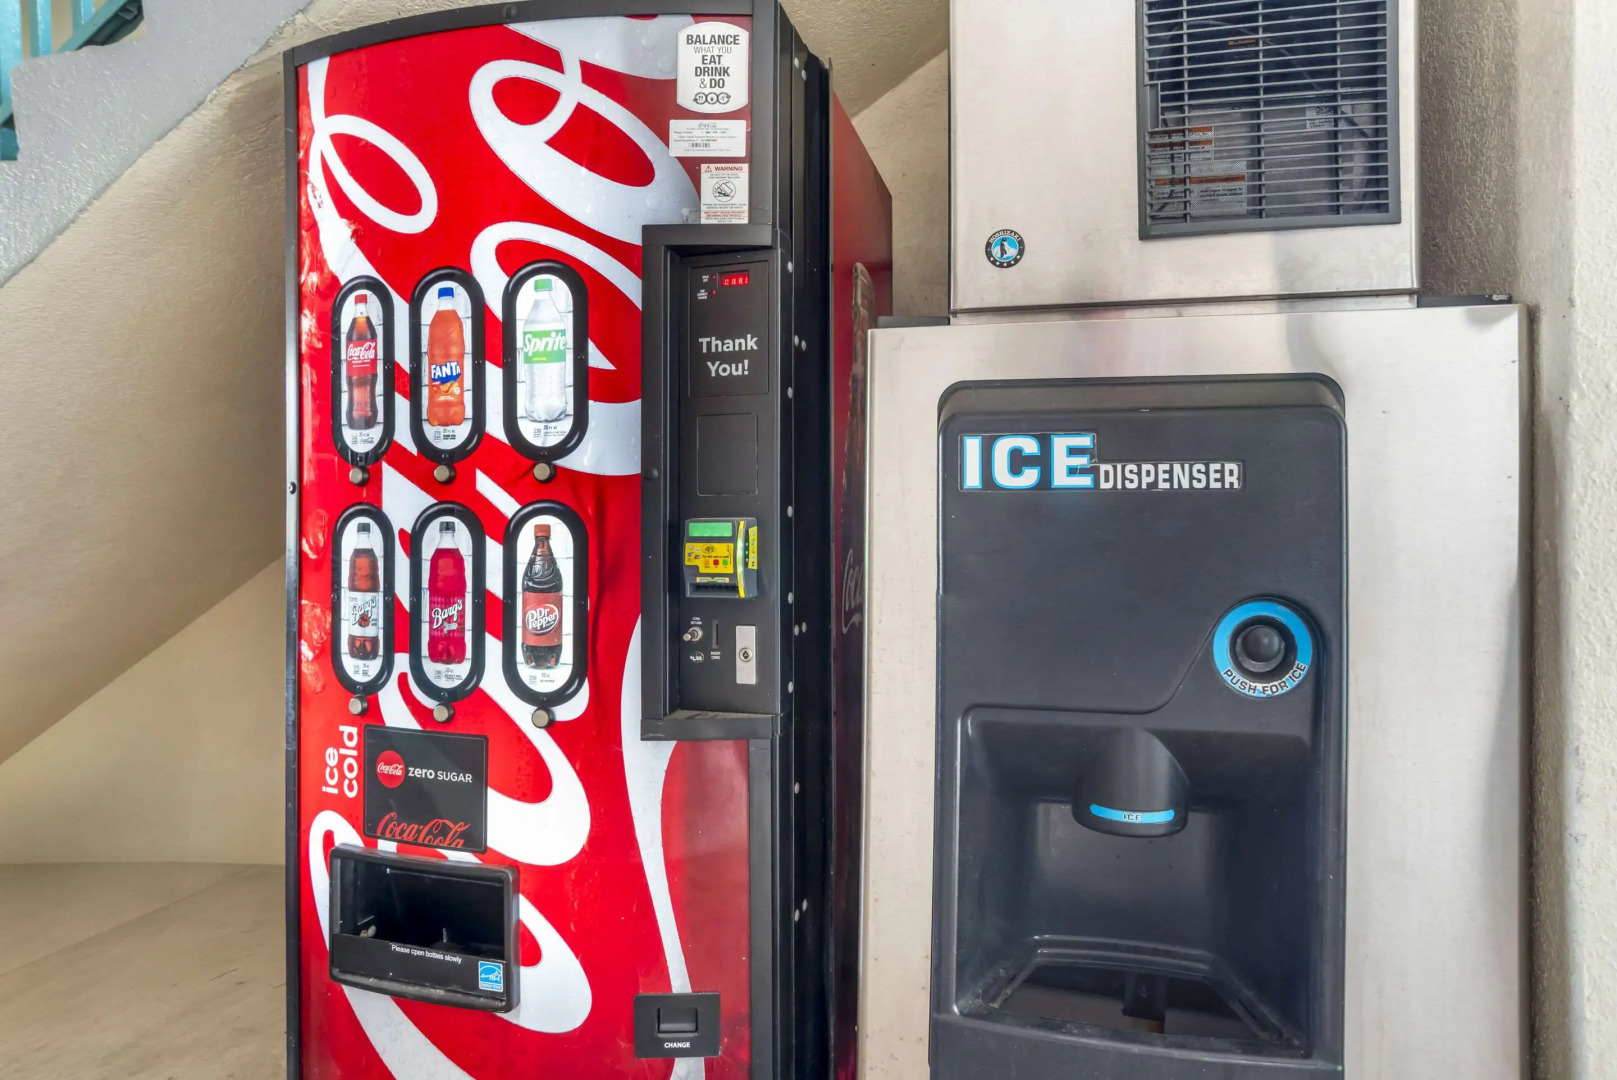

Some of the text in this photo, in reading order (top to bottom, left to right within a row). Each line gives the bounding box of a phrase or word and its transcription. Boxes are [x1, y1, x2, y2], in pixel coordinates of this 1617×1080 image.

[686, 34, 740, 46] BALANCE
[694, 46, 732, 54] WHAT YOU
[694, 66, 731, 77] DRINK
[699, 78, 726, 89] & DO
[347, 341, 376, 361] Coca-Cola
[523, 331, 566, 357] Sprite
[698, 333, 758, 353] Thank
[431, 361, 461, 379] FANTA
[706, 359, 749, 378] You!
[963, 434, 1239, 490] ICE DISPENSER
[431, 599, 463, 630] Barq's
[528, 609, 557, 630] Pepper
[537, 607, 550, 619] Dr
[1223, 661, 1307, 695] PUSH FOR ICE
[322, 747, 339, 794] ice
[339, 725, 358, 798] cold
[376, 761, 404, 776] Coca-Cola
[408, 766, 473, 783] zero SUGAR
[376, 812, 471, 849] Coca-Cola
[391, 944, 462, 964] Please open bottles slowly
